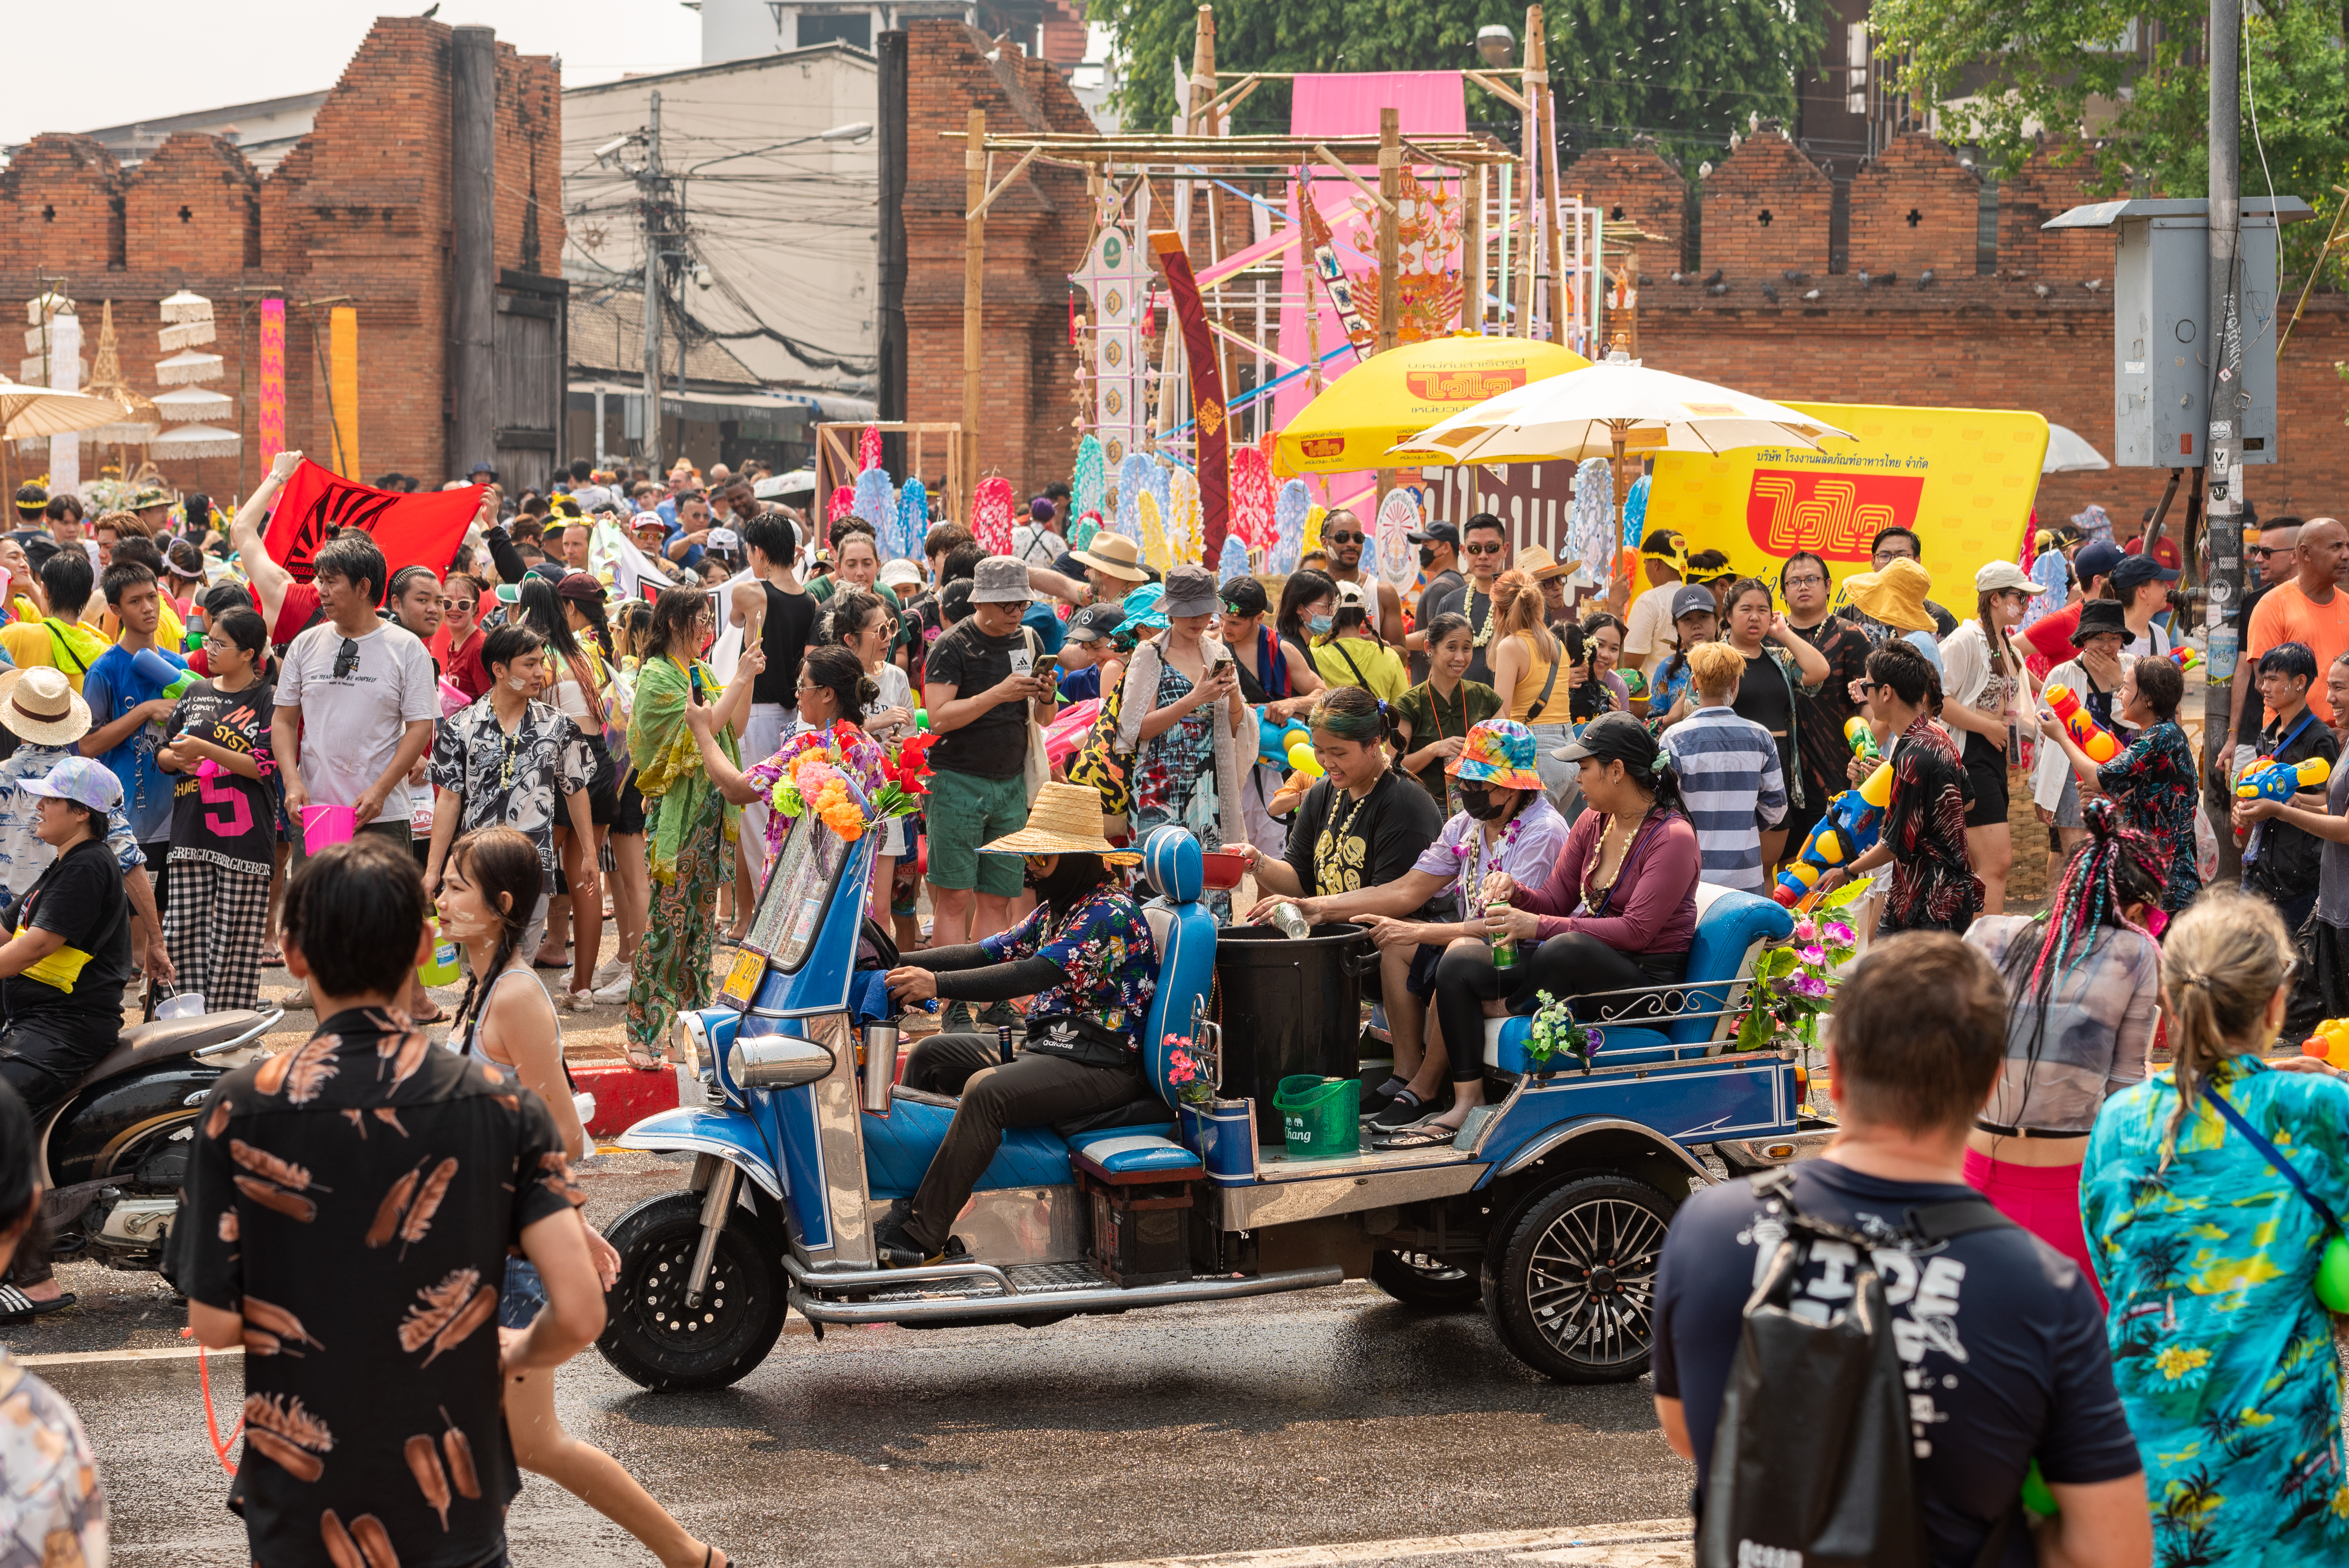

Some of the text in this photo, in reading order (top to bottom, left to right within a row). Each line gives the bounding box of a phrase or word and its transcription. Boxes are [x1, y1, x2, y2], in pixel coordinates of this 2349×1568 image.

[1757, 449, 1929, 469] บริษัท โรงงานผลิตภัณฑ์อาหารไทย จำกัด
[742, 957, 761, 983] 278
[1043, 1039, 1074, 1049] adidas
[1285, 1126, 1311, 1143] Chang
